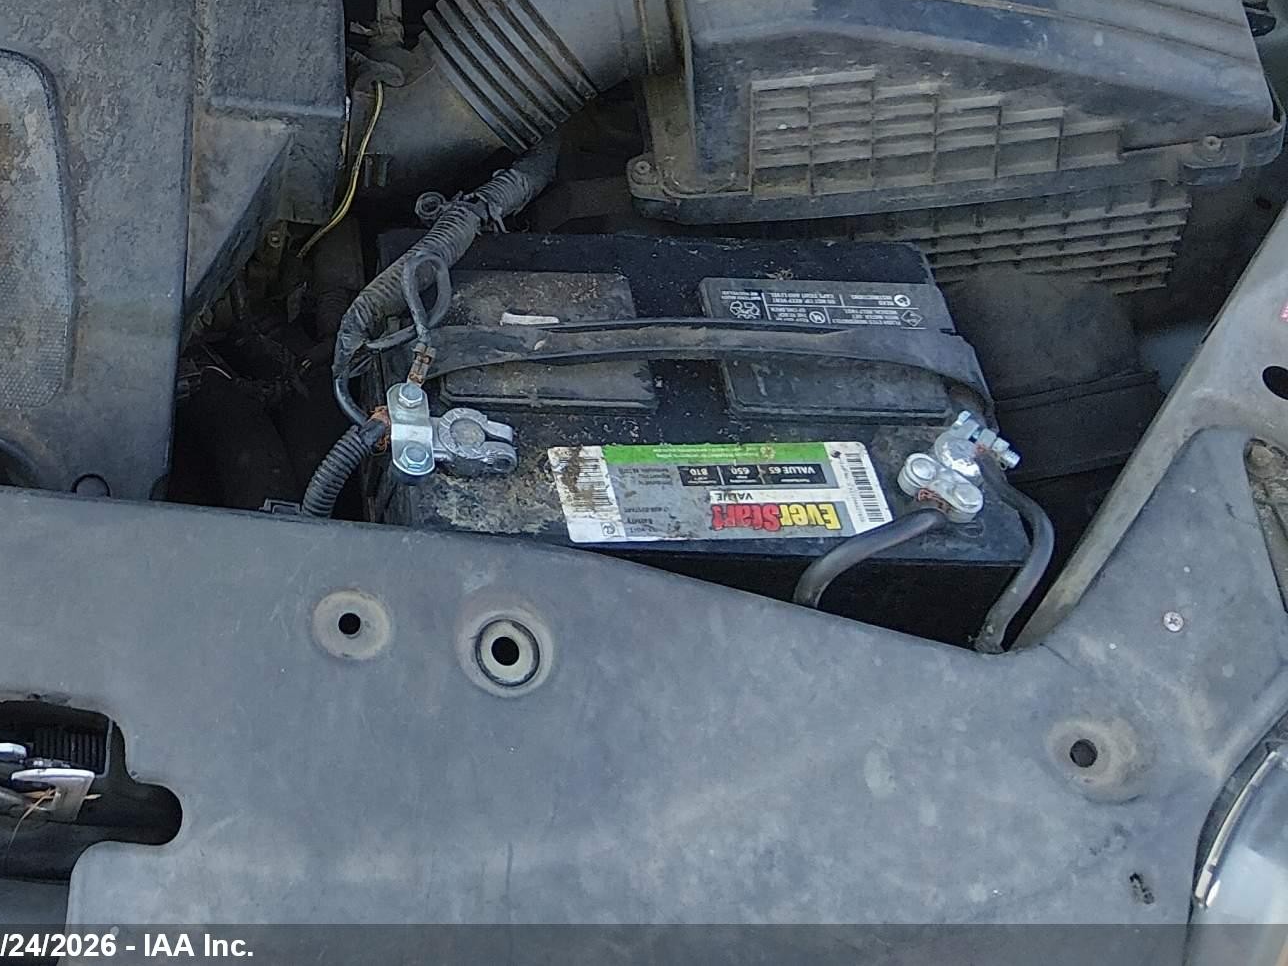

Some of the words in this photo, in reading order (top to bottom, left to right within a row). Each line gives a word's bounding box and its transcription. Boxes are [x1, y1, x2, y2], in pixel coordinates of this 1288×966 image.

[768, 466, 781, 474] 65
[782, 466, 815, 474] VALUE
[717, 492, 753, 501] VALUE
[709, 501, 842, 533] EverStart
